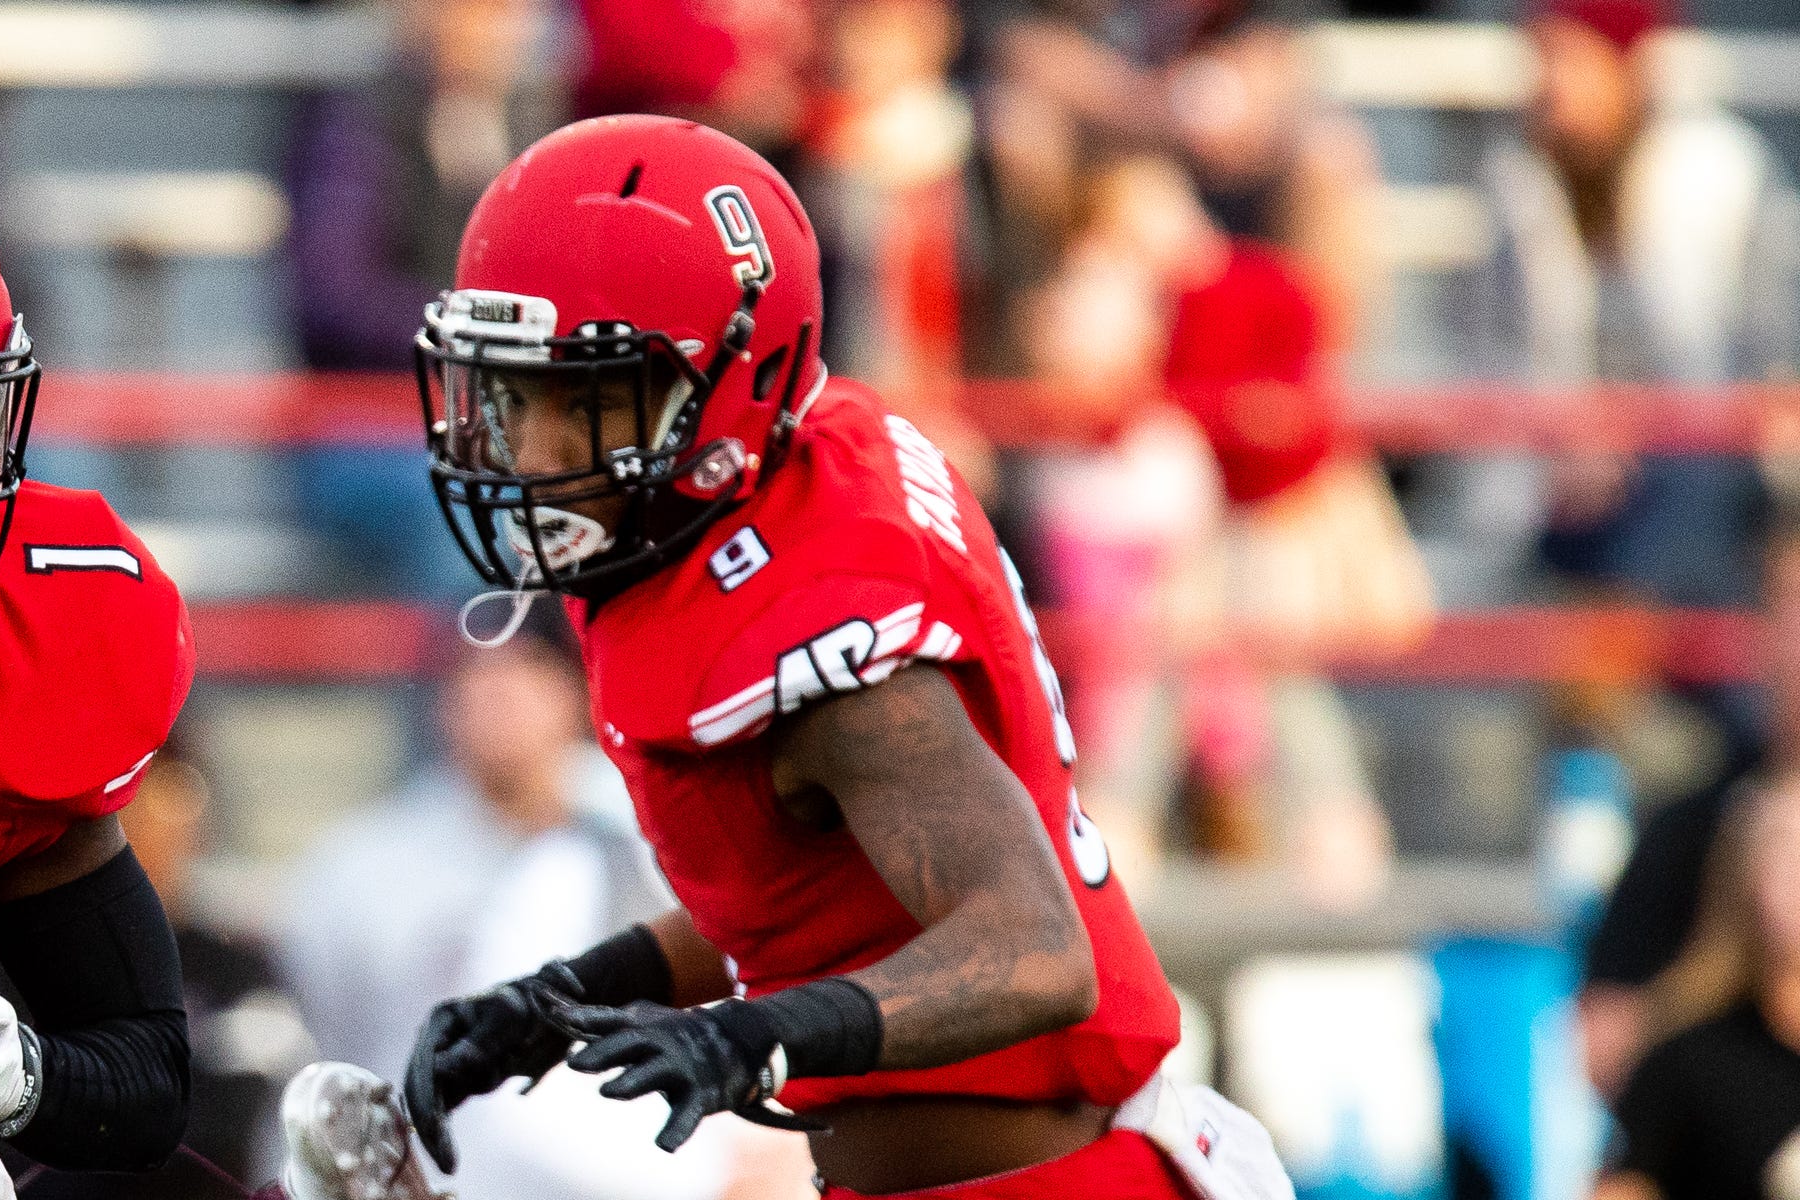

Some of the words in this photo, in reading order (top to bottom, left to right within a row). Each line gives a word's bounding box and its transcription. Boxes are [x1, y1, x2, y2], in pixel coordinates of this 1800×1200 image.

[703, 184, 777, 292] 9
[23, 542, 144, 582] 1
[708, 522, 774, 594] 9
